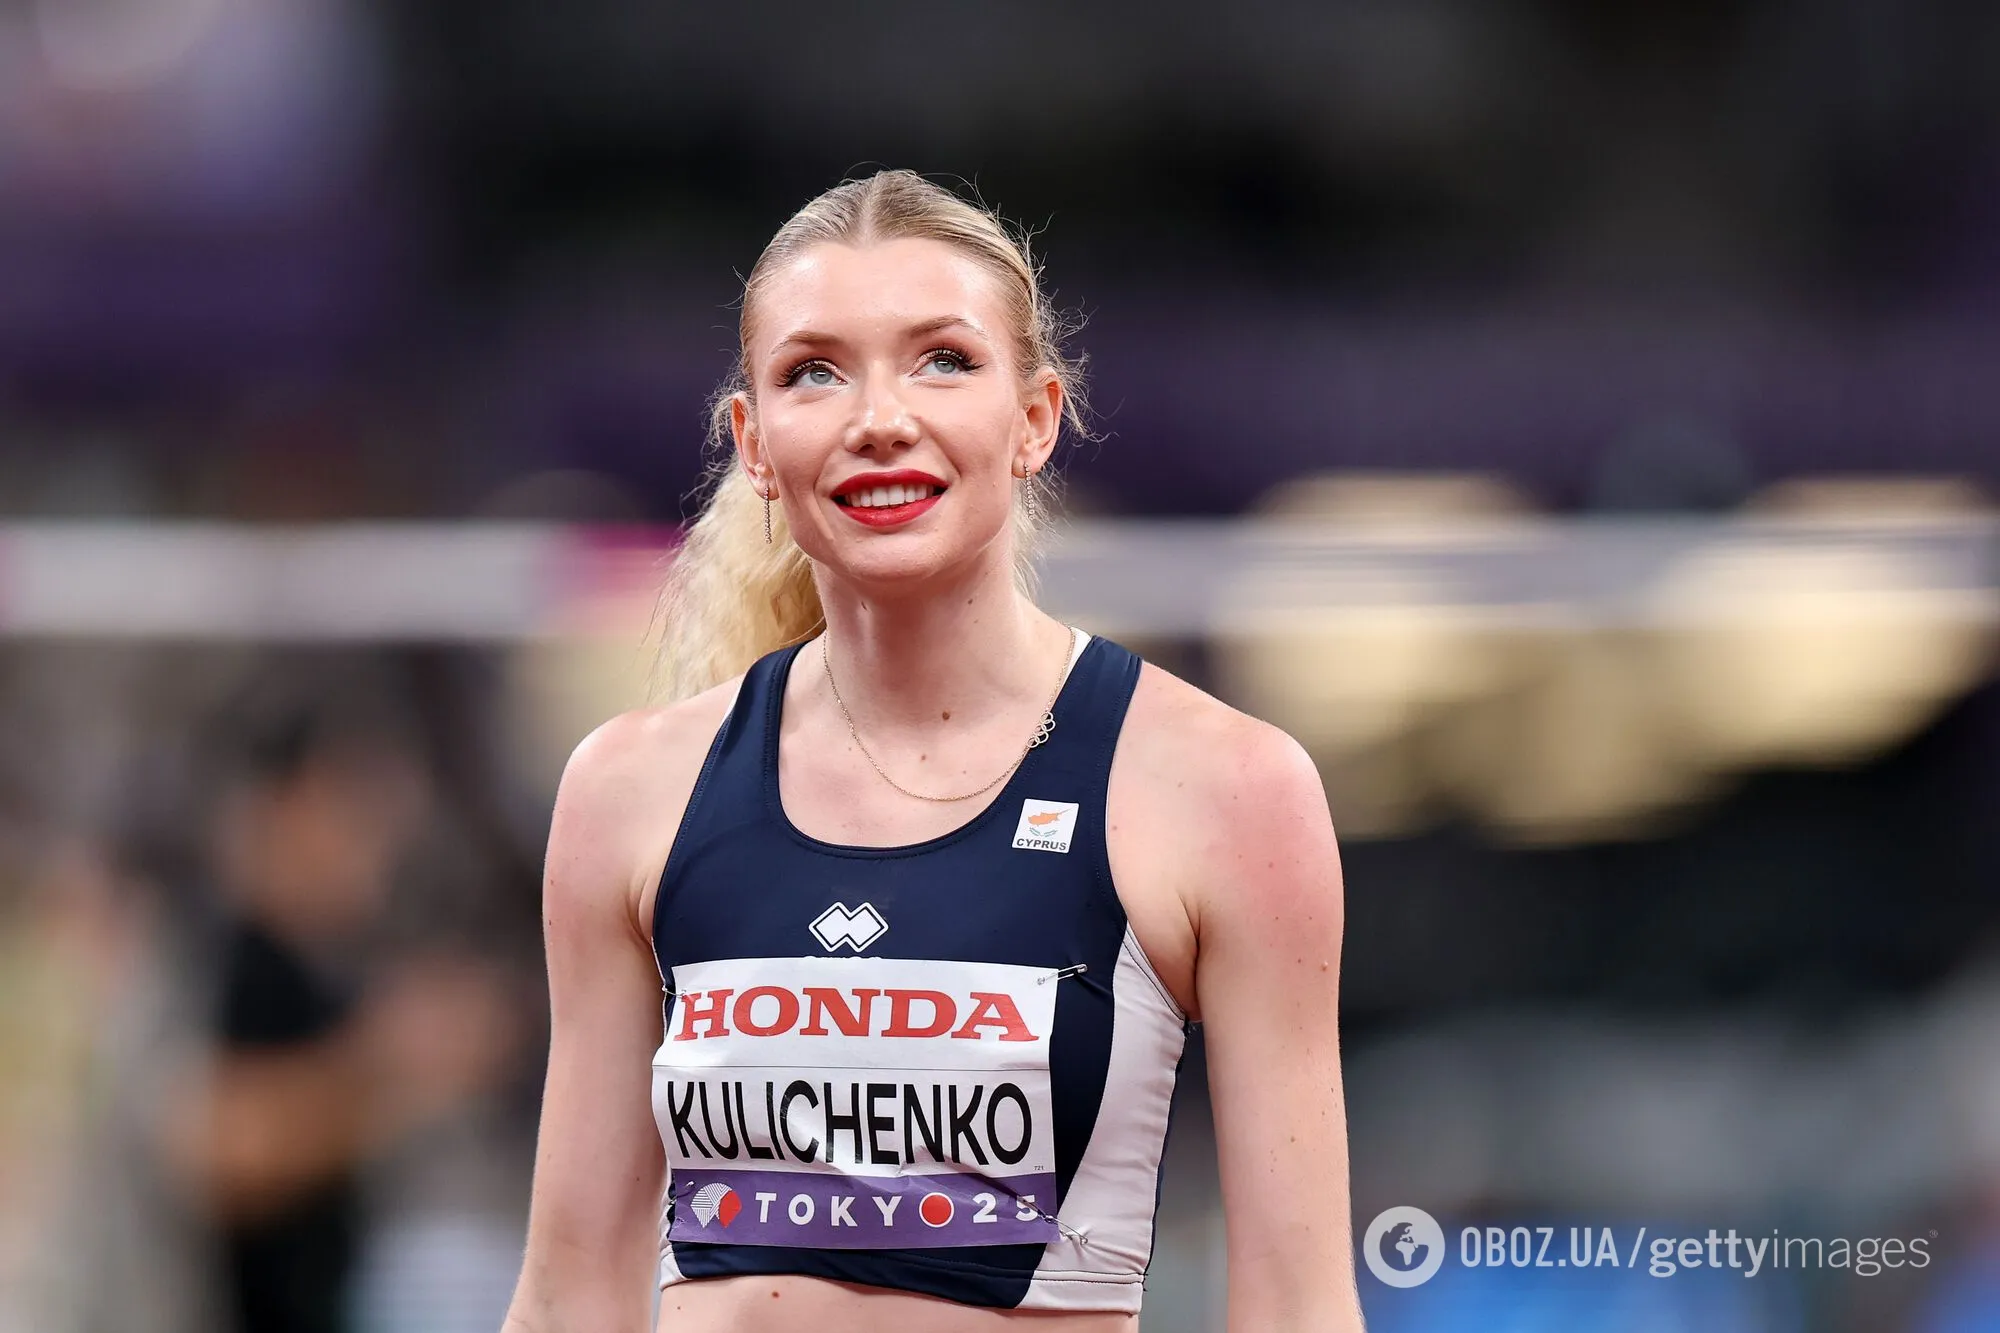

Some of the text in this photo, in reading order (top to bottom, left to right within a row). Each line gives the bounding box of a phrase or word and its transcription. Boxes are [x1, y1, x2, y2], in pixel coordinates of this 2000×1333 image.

[1016, 838, 1067, 851] CYPRUS
[673, 985, 1040, 1042] HONDA
[667, 1079, 1033, 1165] KULICHENKO
[972, 1192, 1039, 1223] 25
